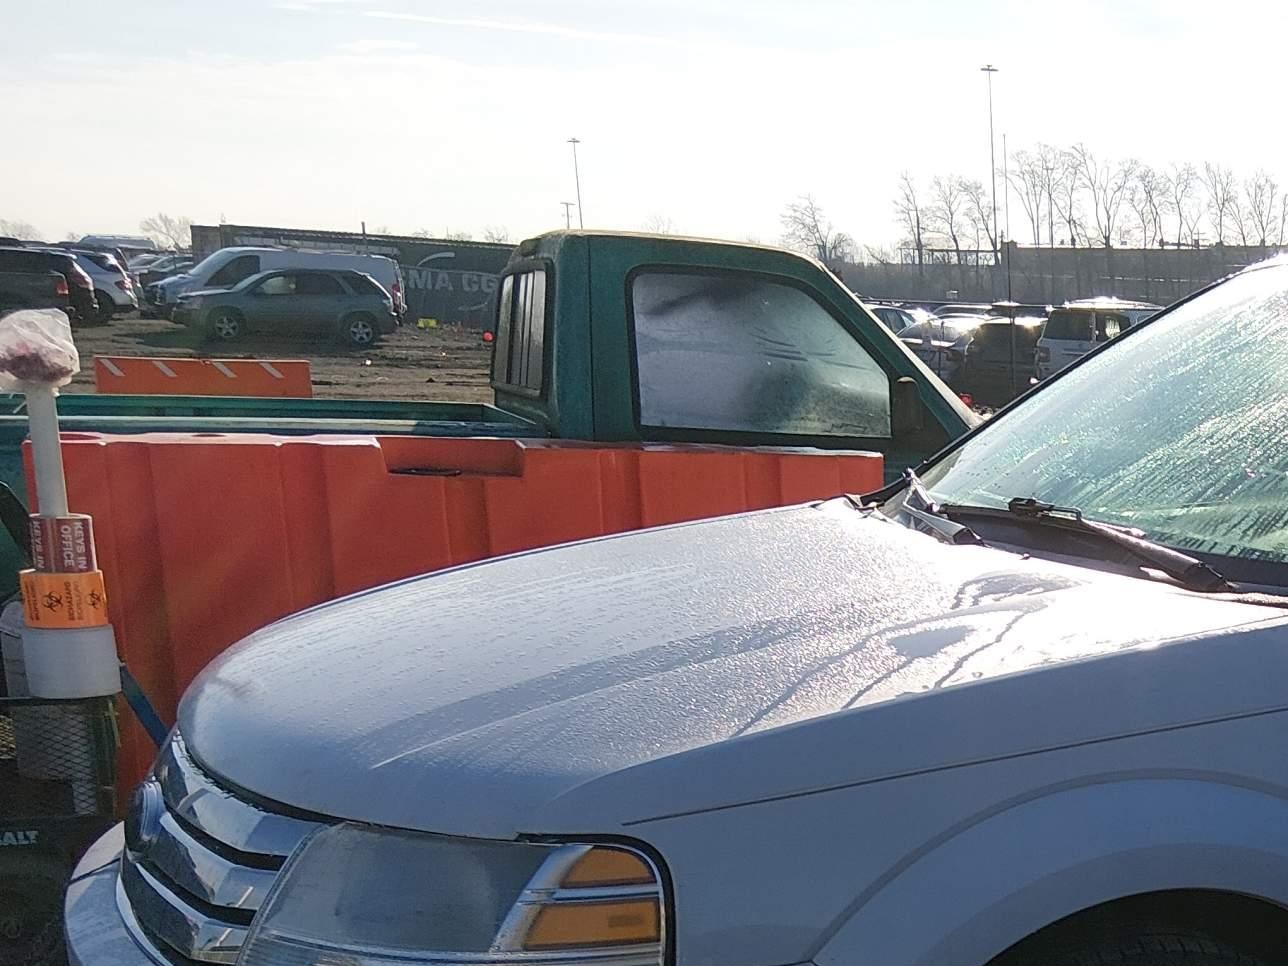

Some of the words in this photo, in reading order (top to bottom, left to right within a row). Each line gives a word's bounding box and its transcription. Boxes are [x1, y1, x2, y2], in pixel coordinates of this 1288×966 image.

[402, 270, 454, 290] MA
[462, 272, 499, 292] CG
[61, 525, 75, 568] OFFICE
[74, 521, 86, 553] KEYS
[77, 556, 88, 569] IN
[0, 831, 39, 845] ALT
